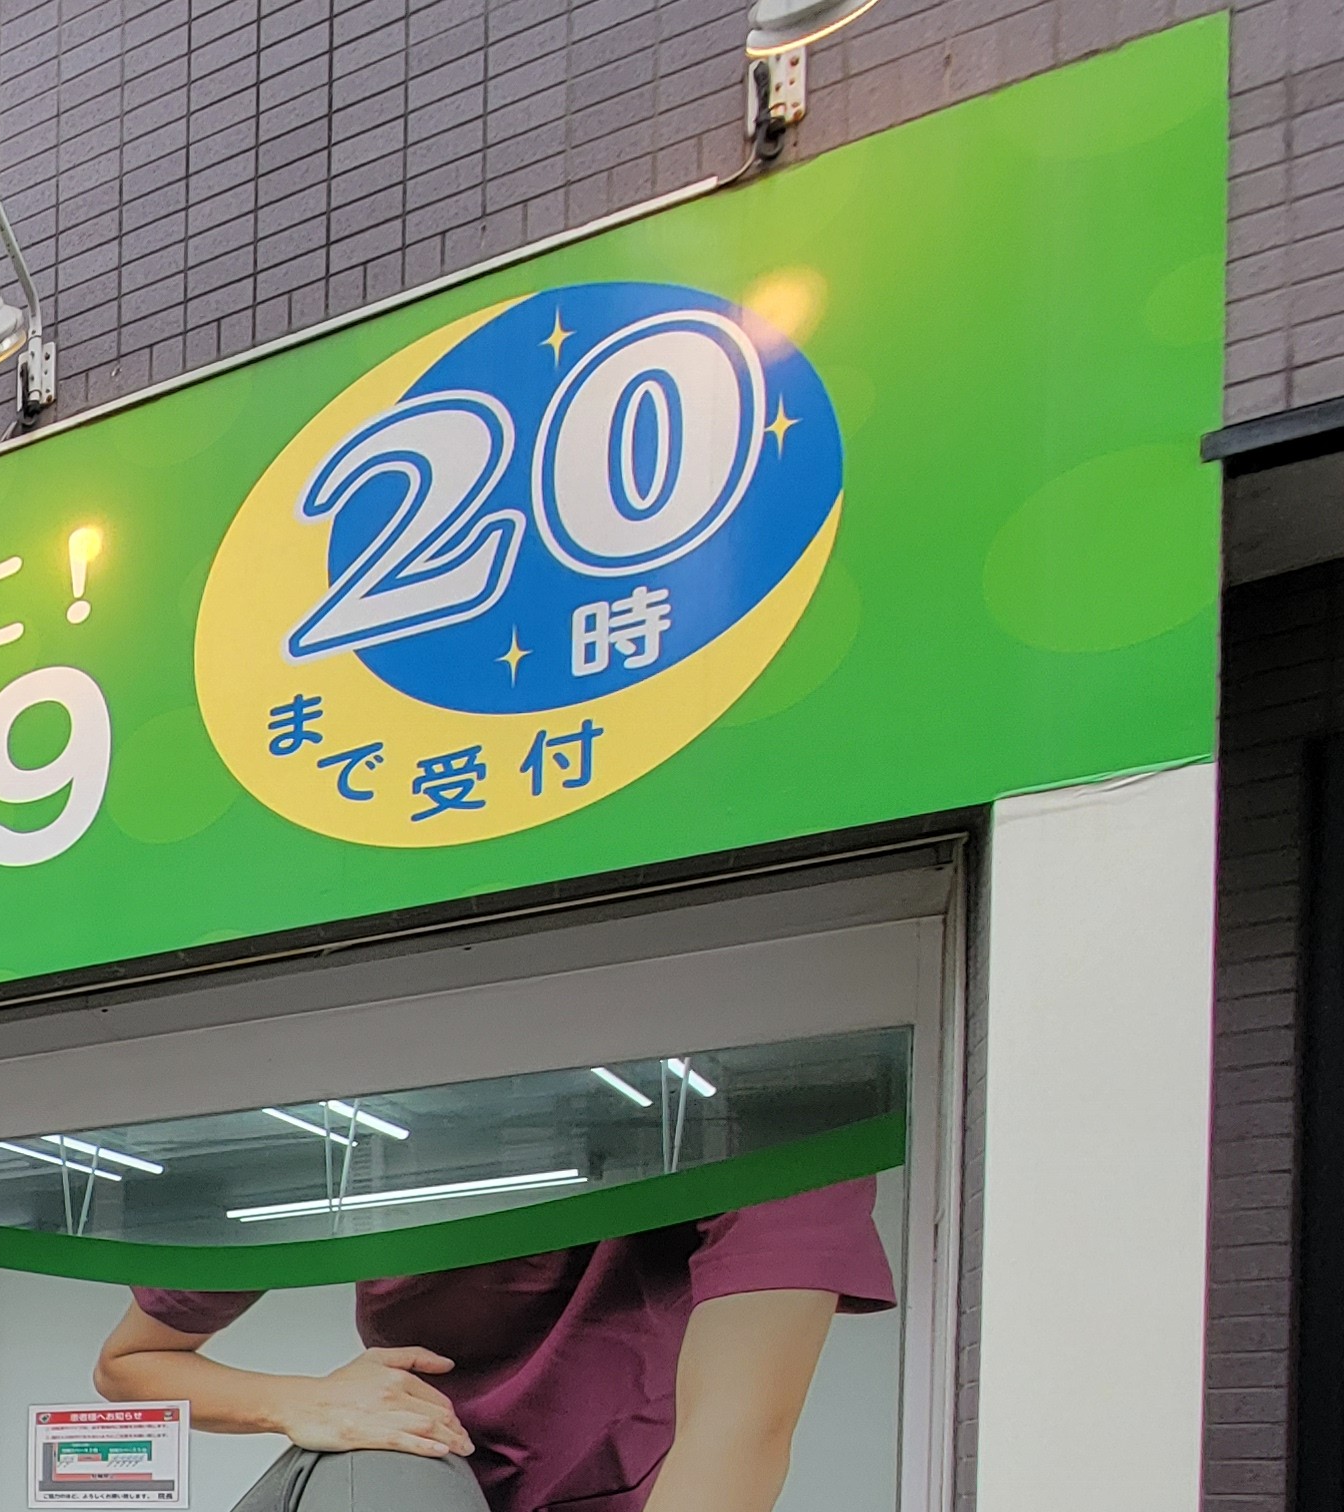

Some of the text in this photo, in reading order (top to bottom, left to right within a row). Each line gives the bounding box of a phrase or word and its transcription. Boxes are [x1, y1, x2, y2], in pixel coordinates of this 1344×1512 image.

[281, 309, 766, 664] 20
[269, 694, 603, 821] まで受付
